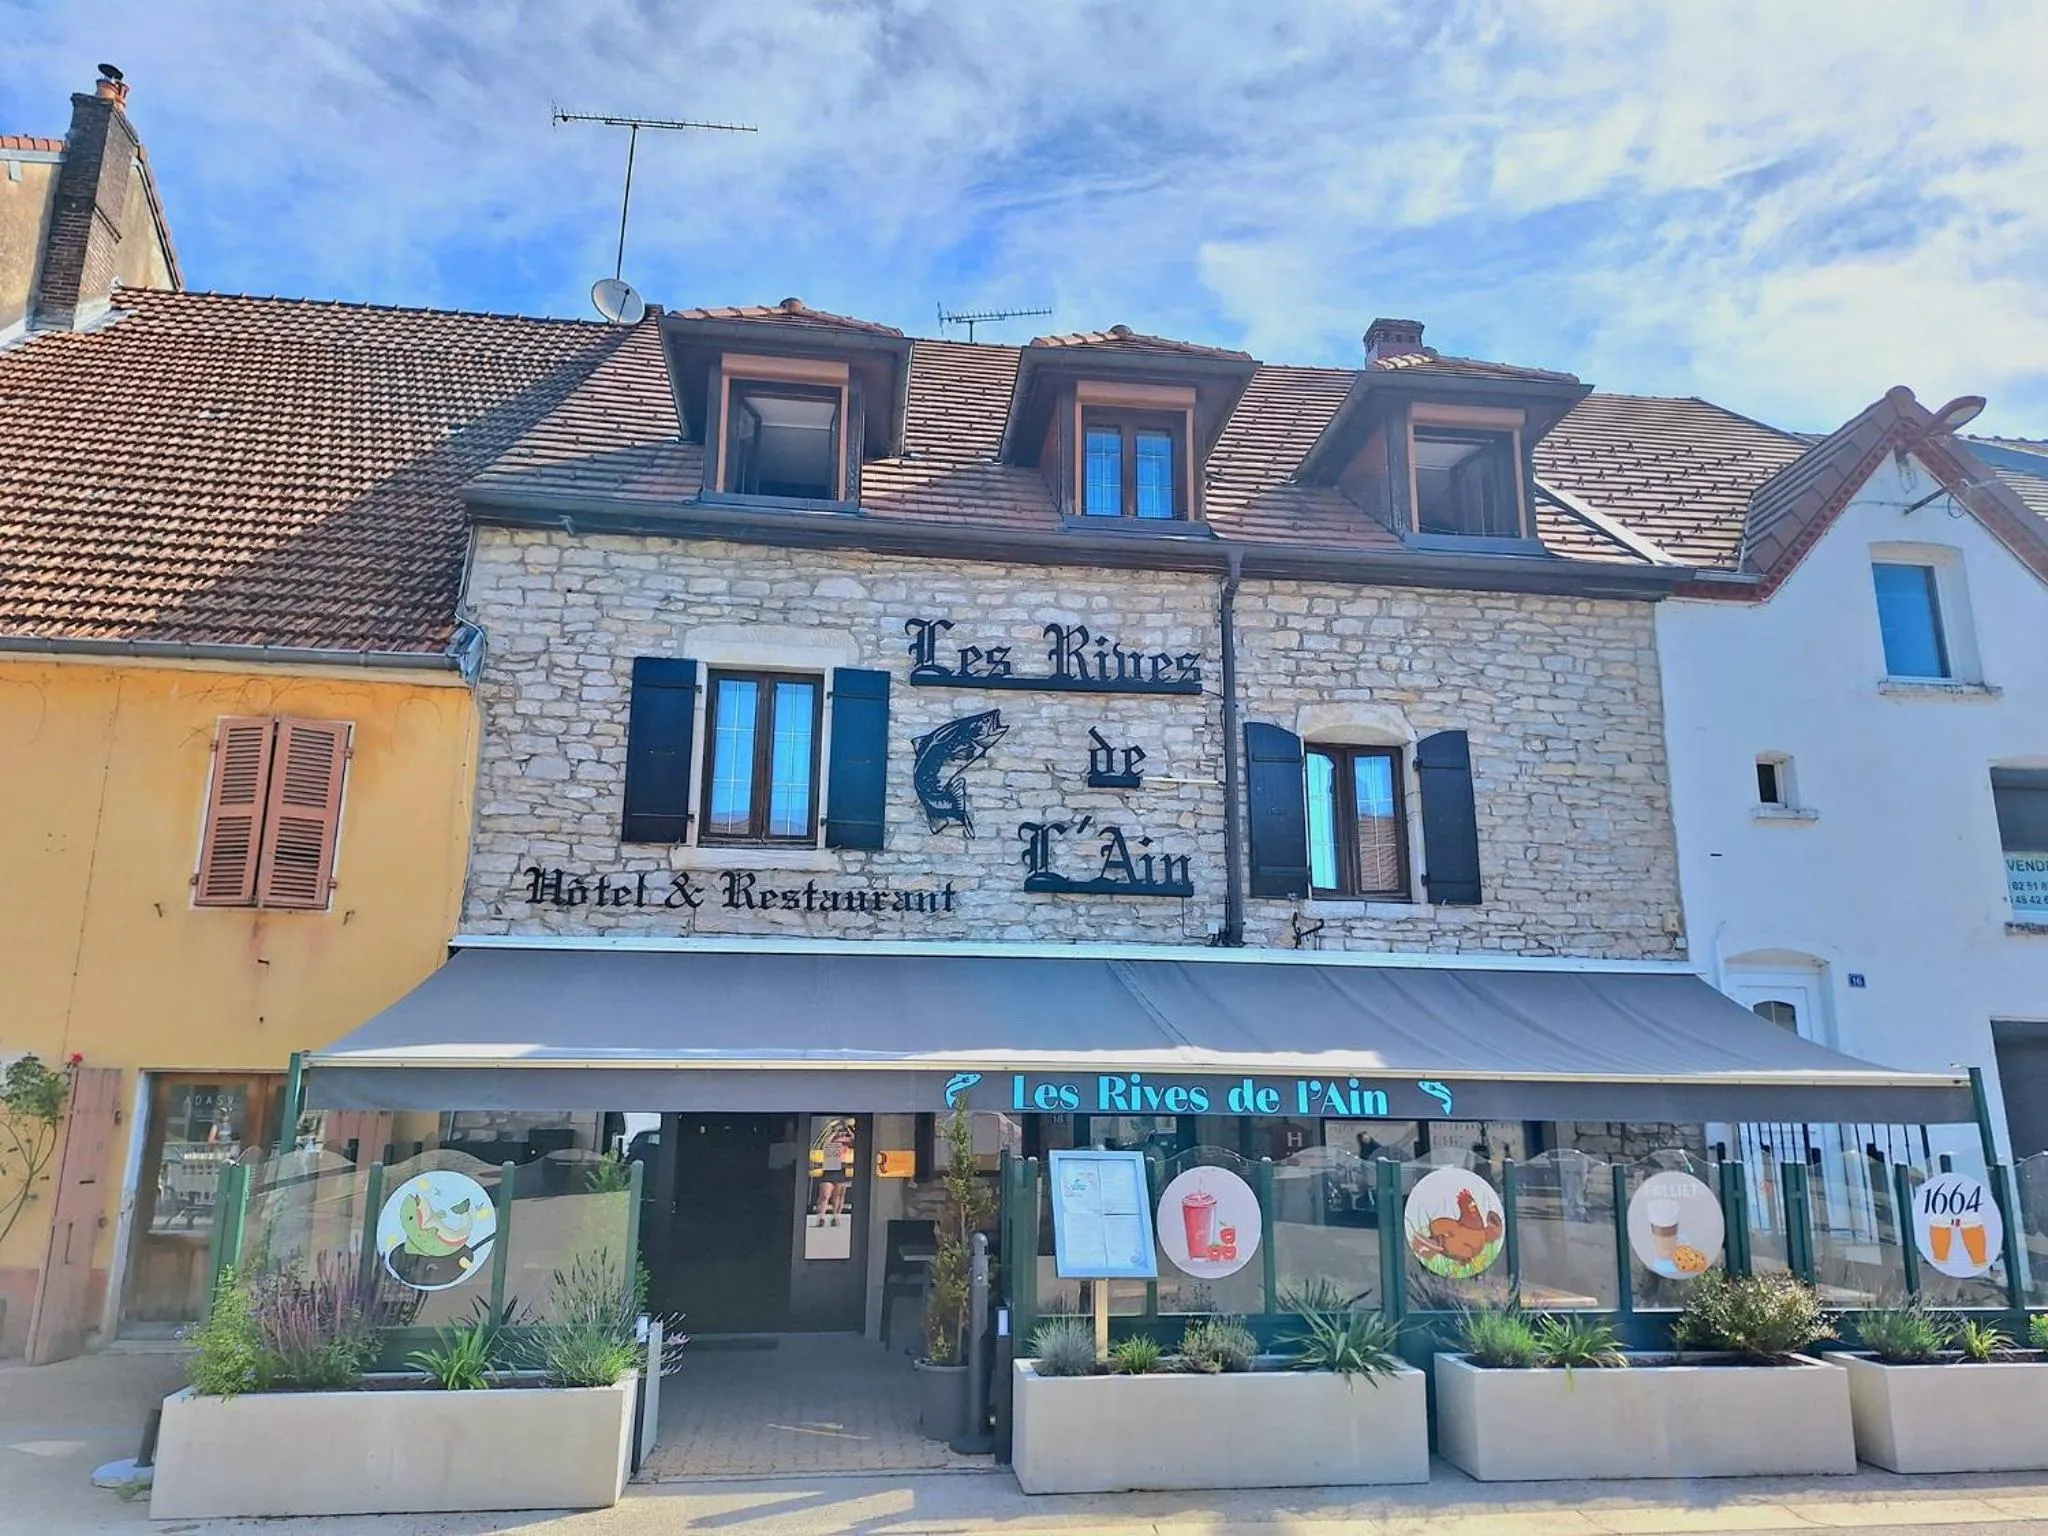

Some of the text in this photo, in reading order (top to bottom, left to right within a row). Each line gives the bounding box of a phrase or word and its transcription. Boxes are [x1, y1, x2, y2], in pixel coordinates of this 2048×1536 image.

[904, 618, 1201, 683] Les Rives
[1088, 725, 1147, 778] de
[523, 866, 956, 913] Hôtel & Restaurant
[1013, 1074, 1080, 1110] Les
[1098, 1073, 1210, 1112] Rives
[1228, 1078, 1281, 1113] de
[1287, 1131, 1302, 1148] H
[1924, 1182, 1984, 1215] 1664
